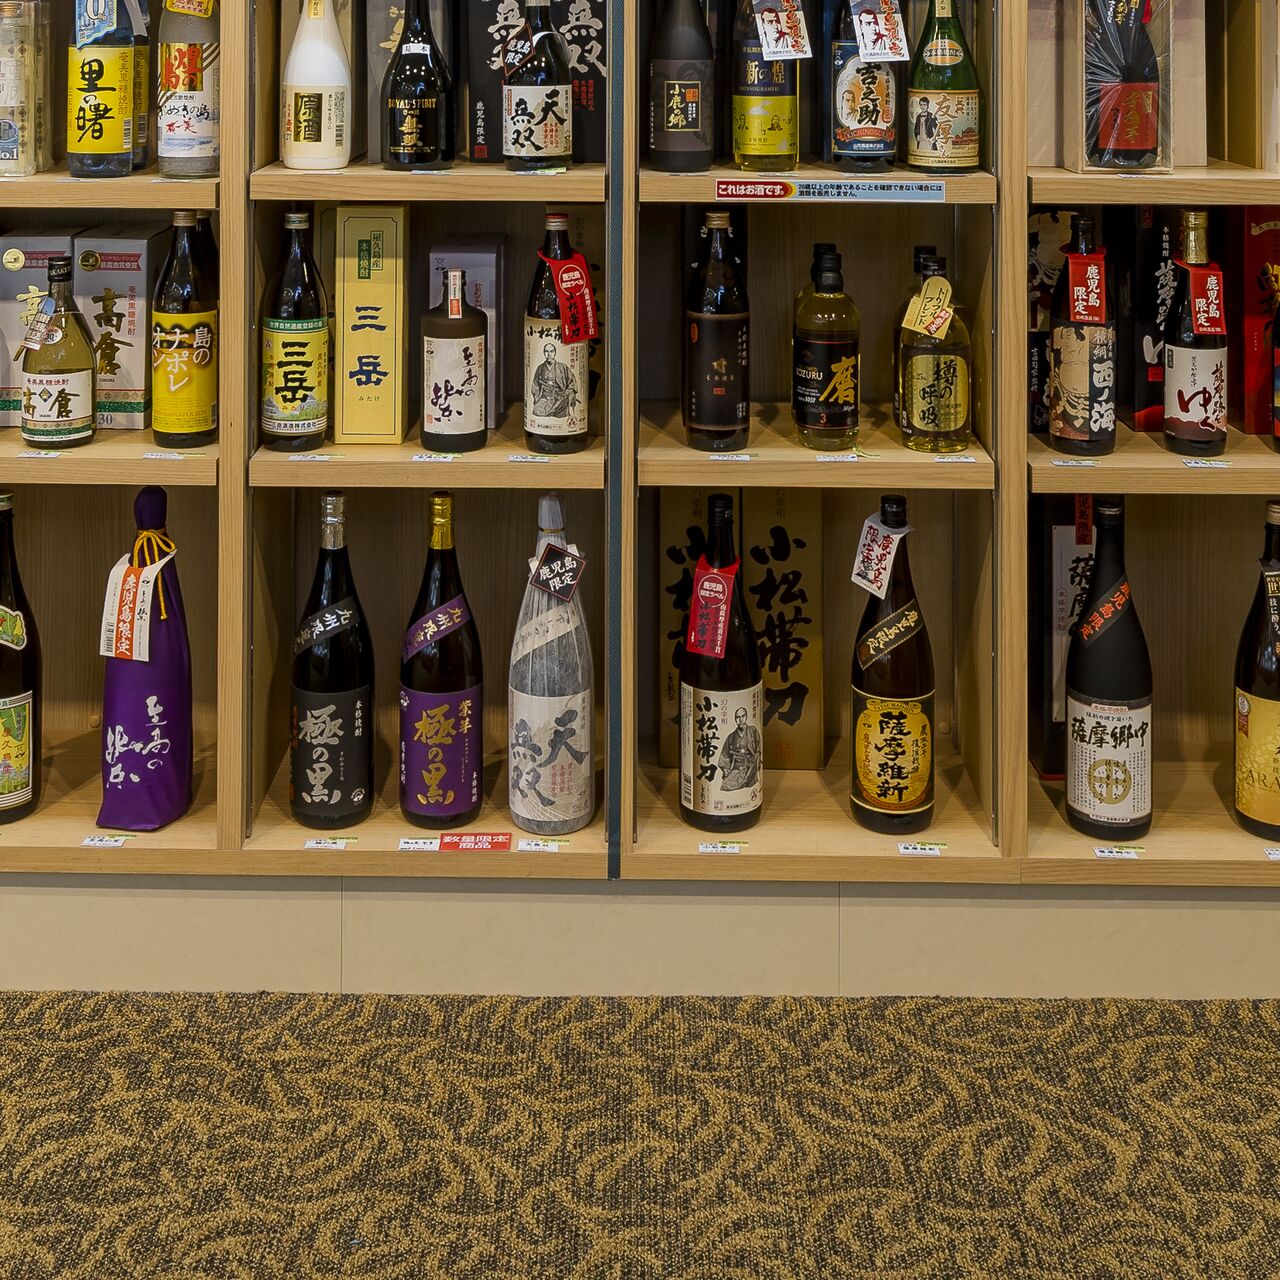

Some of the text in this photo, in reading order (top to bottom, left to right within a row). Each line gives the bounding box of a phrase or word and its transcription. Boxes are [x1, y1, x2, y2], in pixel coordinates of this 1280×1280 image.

[505, 52, 523, 65] 限定
[75, 58, 116, 143] 里の曙
[295, 92, 322, 142] 原酒
[538, 89, 568, 126] 天
[476, 100, 486, 144] 鹿児島限定
[511, 97, 544, 153] 無双
[718, 183, 785, 196] これはお酒です。
[798, 183, 942, 191] 20歳以上の年齢であることを確認できない場合には
[359, 241, 369, 278] 本格焼酎
[371, 232, 382, 270] 屋久島産
[1162, 226, 1170, 257] 本格焼酎
[1074, 287, 1088, 314] 限定
[1086, 264, 1101, 306] 鹿児島
[1205, 275, 1220, 318] 鹿児島
[127, 285, 136, 335] 奄美黒糖焼酎
[1195, 298, 1210, 326] 限定
[91, 287, 134, 376] 高倉
[193, 326, 211, 365] 島の
[348, 305, 390, 387] 三岳
[1092, 329, 1109, 359] 横綱
[166, 326, 189, 393] ナポレ
[274, 340, 315, 404] 三岳
[23, 387, 81, 419] 高倉
[1089, 362, 1115, 432] 西ノ海
[1177, 386, 1217, 430] ゆく
[98, 413, 113, 425] 30
[819, 412, 827, 424] 3
[539, 557, 577, 580] 鹿児島
[548, 573, 576, 591] 限定
[117, 575, 135, 654] 鹿児島限定
[749, 525, 811, 726] 小松帯刀
[1079, 582, 1131, 640] 鹿児島限定
[355, 699, 364, 738] 本格焼酎
[458, 701, 472, 733] 紫芋
[1071, 716, 1149, 749] 薩摩郷中
[299, 705, 344, 805] 極の黒
[414, 705, 457, 805] 極の黒
[546, 709, 589, 768] 天
[695, 696, 721, 783] 小松帯刀
[875, 712, 912, 802] 薩摩維新
[442, 835, 510, 843] 数量限定
[458, 842, 492, 850] 商品
